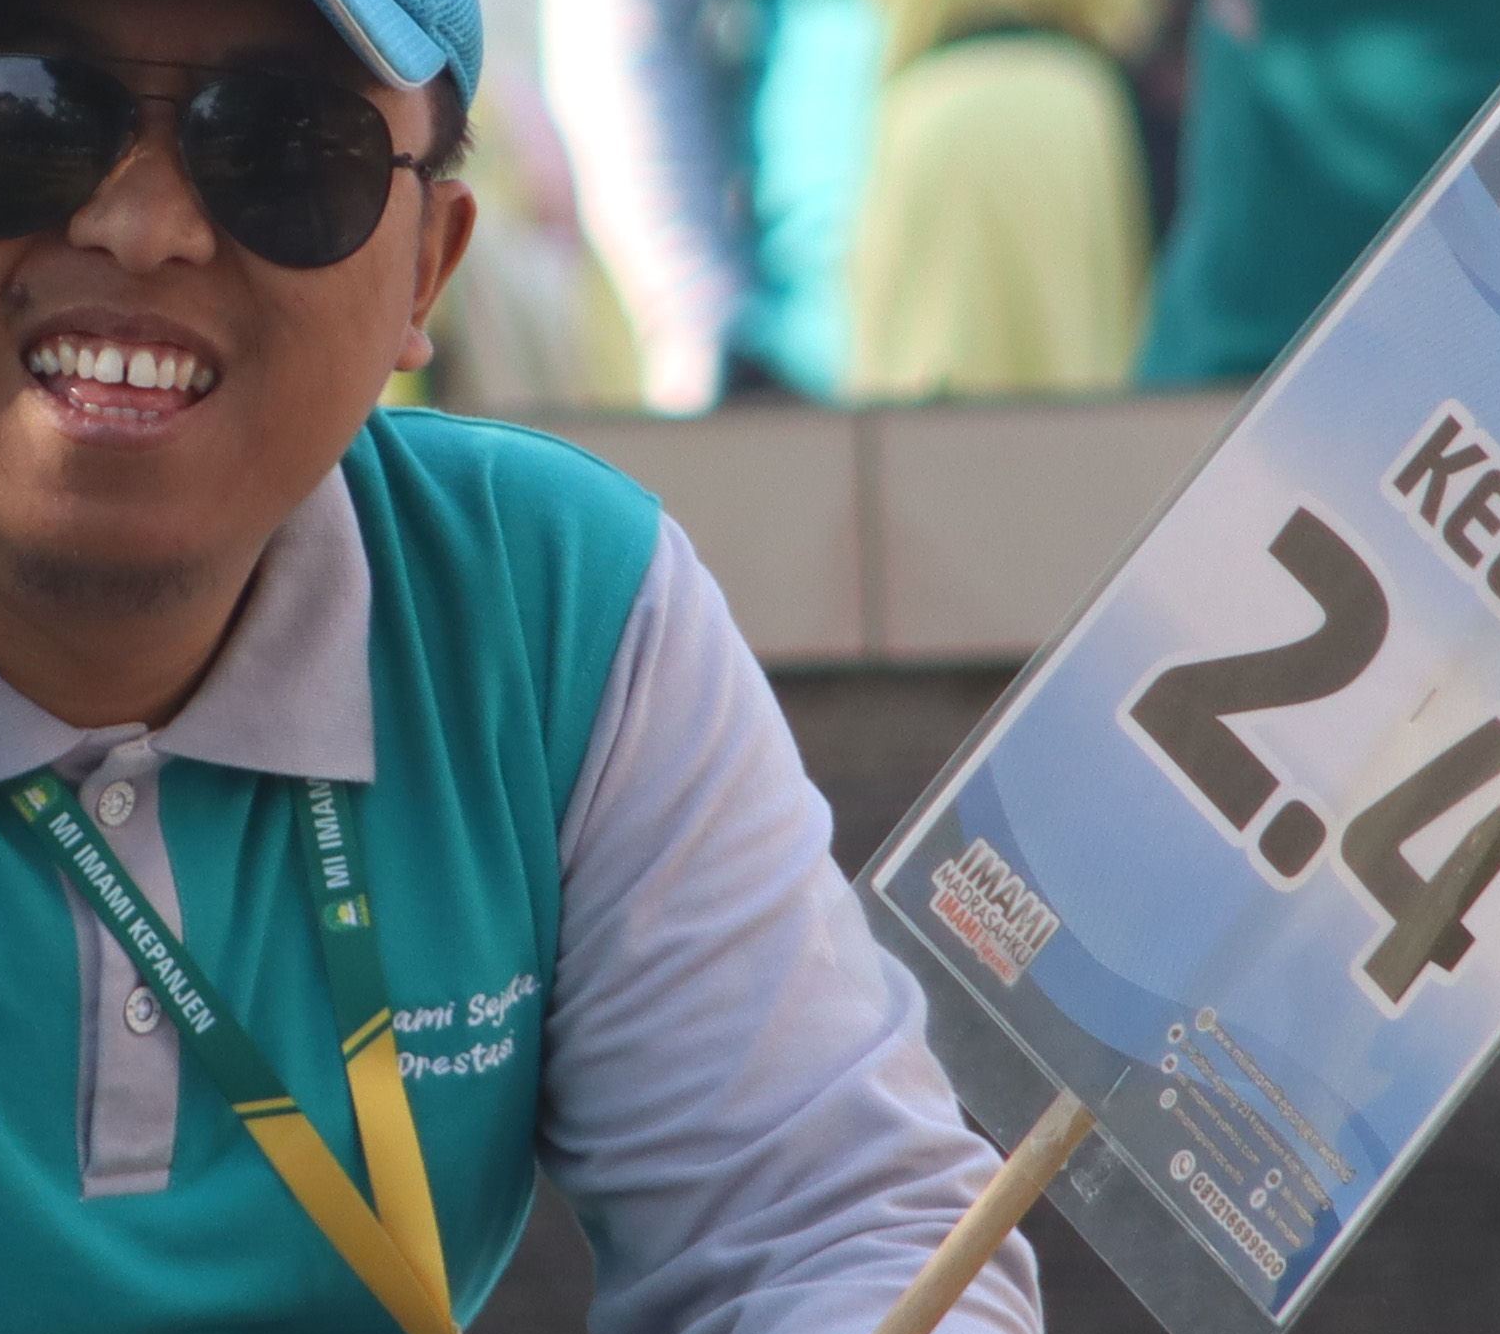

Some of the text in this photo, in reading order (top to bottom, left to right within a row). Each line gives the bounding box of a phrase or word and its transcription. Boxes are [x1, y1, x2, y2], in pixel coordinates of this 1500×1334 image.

[305, 777, 351, 890] MI IMAM
[48, 811, 216, 1035] MI IMAMI KEPANJEN
[935, 889, 984, 944] IMAMI
[936, 865, 1034, 966] MADRASAHKU
[958, 844, 1057, 950] IMAMI
[392, 1000, 456, 1033] ami
